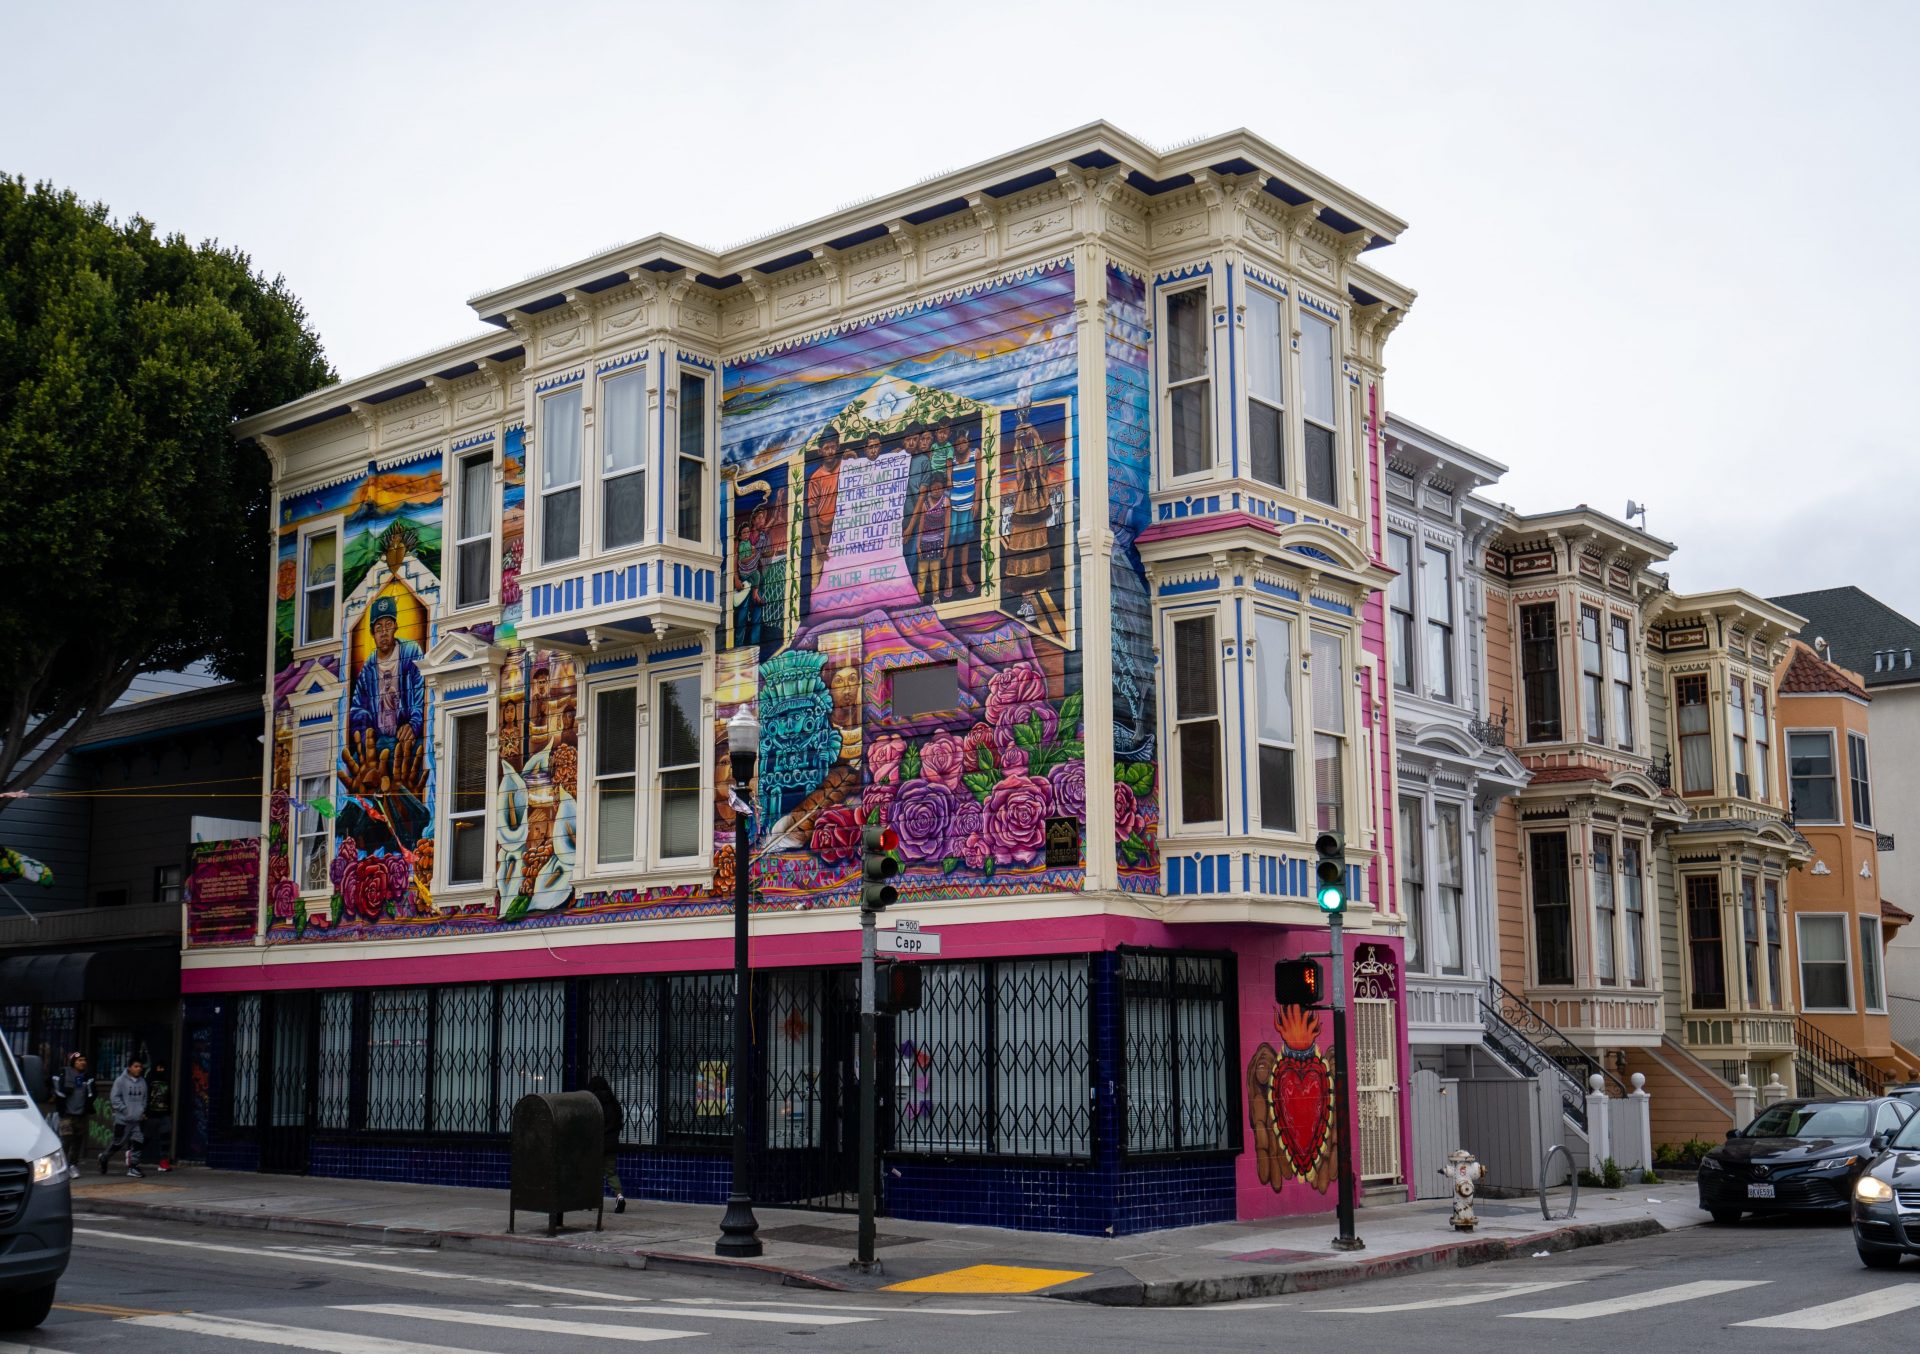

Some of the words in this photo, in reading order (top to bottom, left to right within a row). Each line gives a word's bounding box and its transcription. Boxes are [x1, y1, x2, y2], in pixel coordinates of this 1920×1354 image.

[873, 454, 907, 471] PEREZ
[838, 475, 863, 491] LOPEZ
[836, 504, 846, 517] DE
[831, 530, 846, 545] POR
[849, 529, 860, 541] LA
[891, 521, 901, 533] DE
[869, 564, 897, 581] PEREZ
[906, 921, 917, 929] 900
[895, 936, 921, 951] Capp
[1304, 968, 1314, 993] 4
